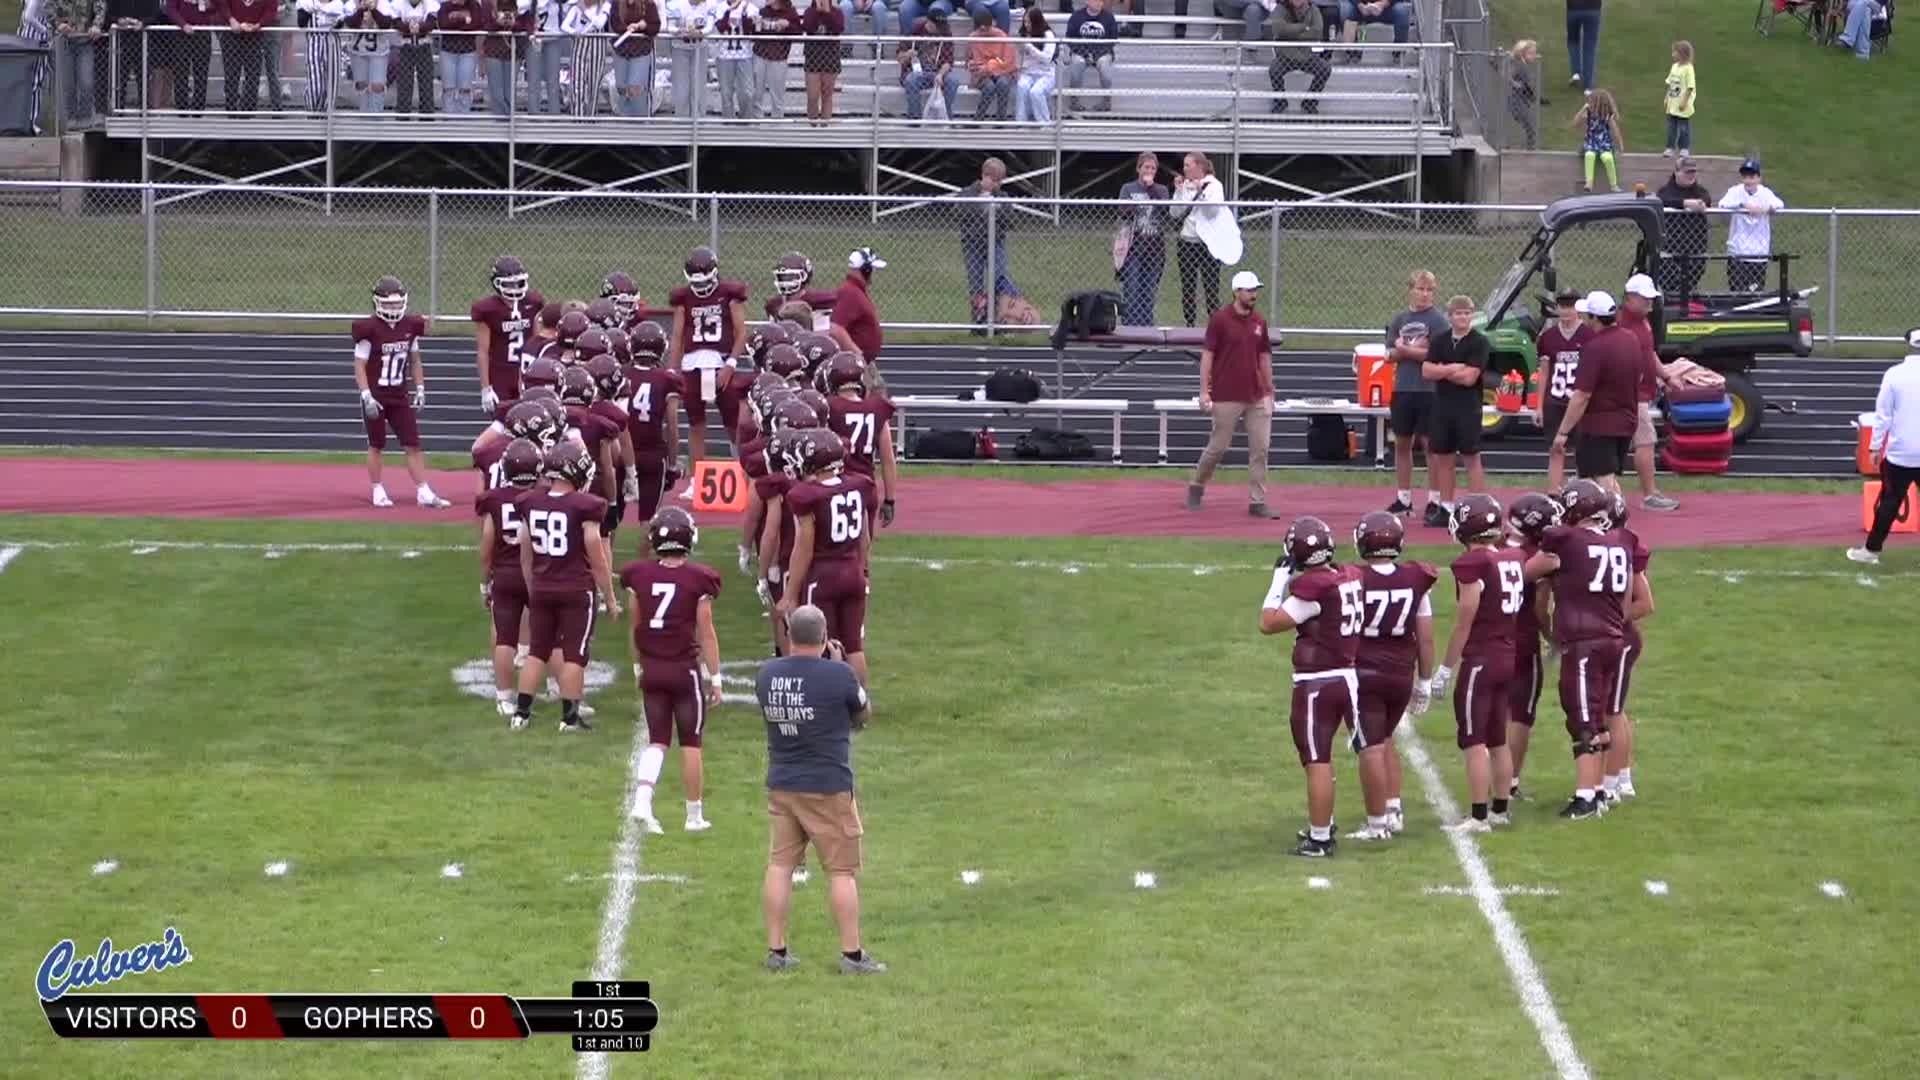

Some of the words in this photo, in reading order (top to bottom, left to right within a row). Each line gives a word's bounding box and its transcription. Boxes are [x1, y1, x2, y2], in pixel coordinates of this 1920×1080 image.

[508, 331, 524, 362] 2
[378, 352, 407, 386] 10
[632, 383, 651, 422] 4
[845, 413, 875, 453] 71
[700, 467, 737, 504] 50
[529, 509, 568, 556] 58
[830, 490, 862, 543] 63
[1587, 545, 1628, 593] 78
[650, 583, 676, 628] 7
[1338, 579, 1365, 636] 55
[1363, 587, 1414, 637] 77
[767, 691, 784, 706] LET
[785, 691, 805, 706] THE
[770, 676, 804, 691] DON'T
[778, 723, 799, 737] WIN
[787, 706, 815, 721] DAYS
